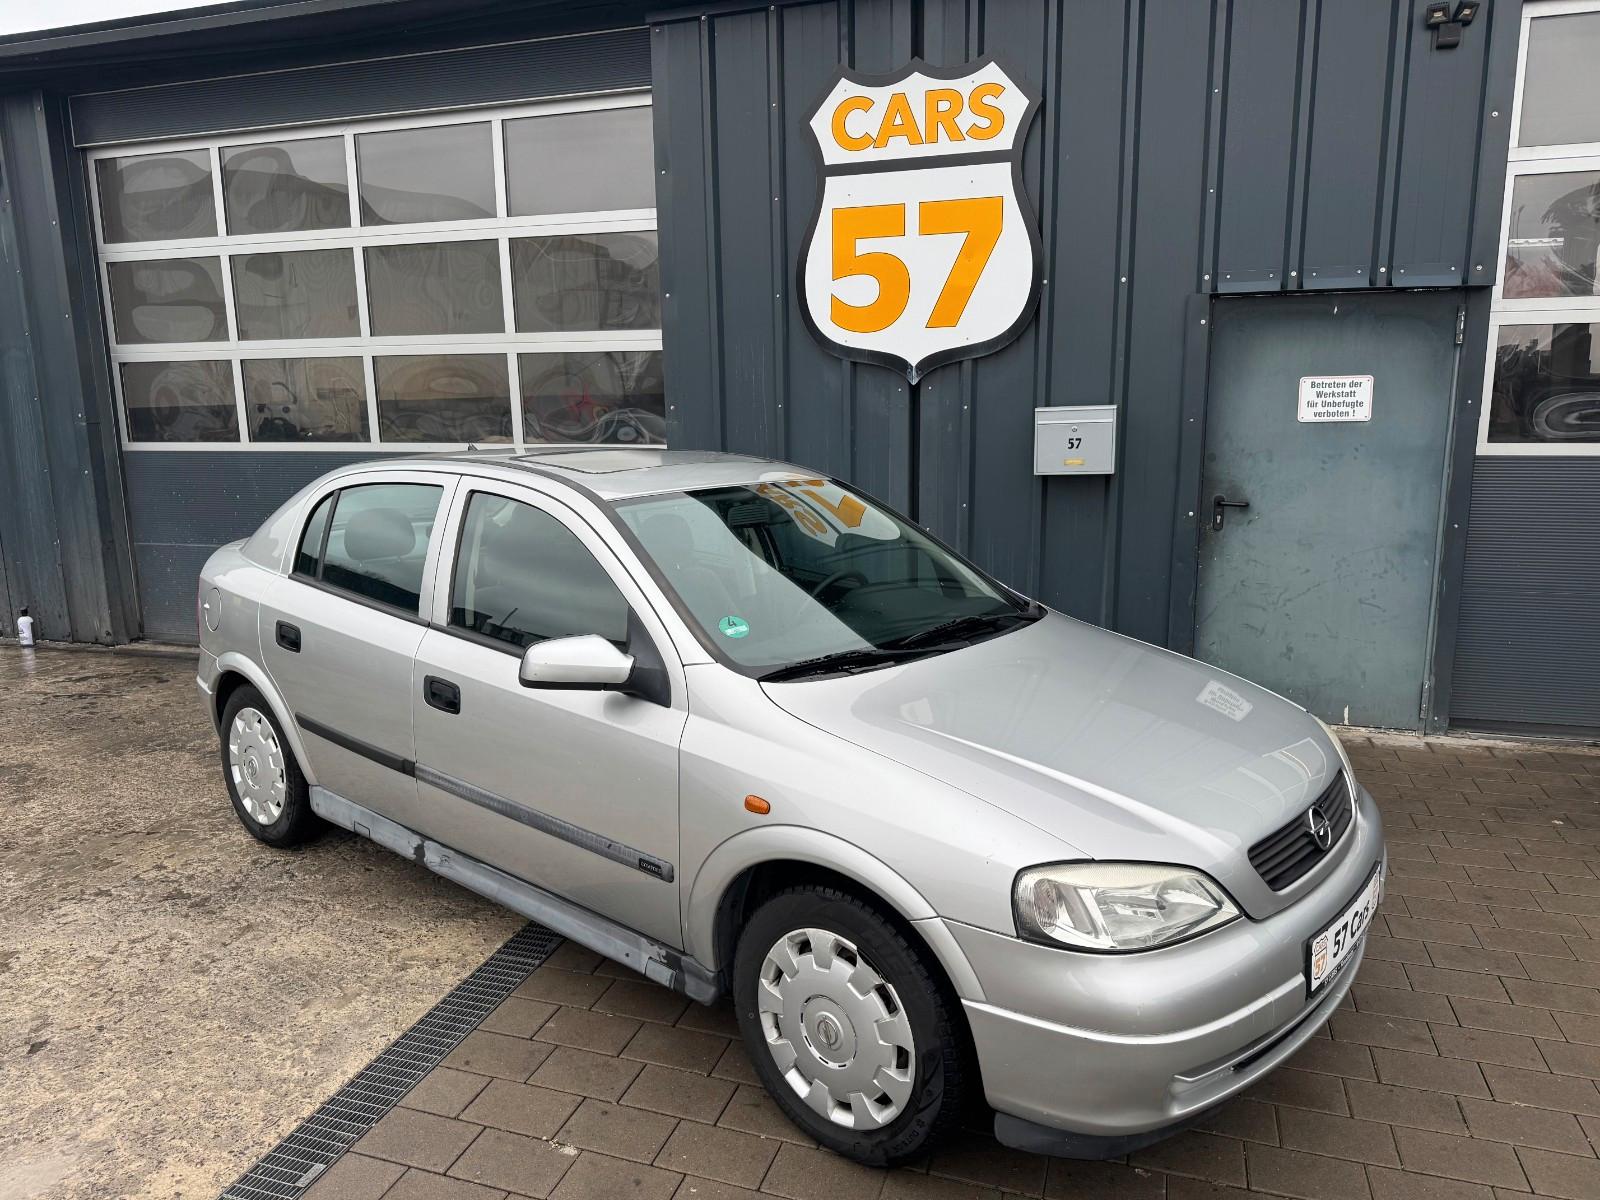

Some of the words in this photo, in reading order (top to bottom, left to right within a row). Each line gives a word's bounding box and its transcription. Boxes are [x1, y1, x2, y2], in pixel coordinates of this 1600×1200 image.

[831, 82, 1006, 151] CARS
[830, 196, 1004, 333] 57
[1310, 380, 1346, 389] Betreten
[1349, 380, 1363, 388] der
[1315, 390, 1356, 398] Werkstatt
[1306, 400, 1318, 408] für
[1321, 400, 1364, 409] Unbefugte
[1313, 409, 1350, 418] verboten
[1067, 438, 1082, 450] 57
[1333, 921, 1348, 958] 57
[1350, 900, 1370, 938] Cars
